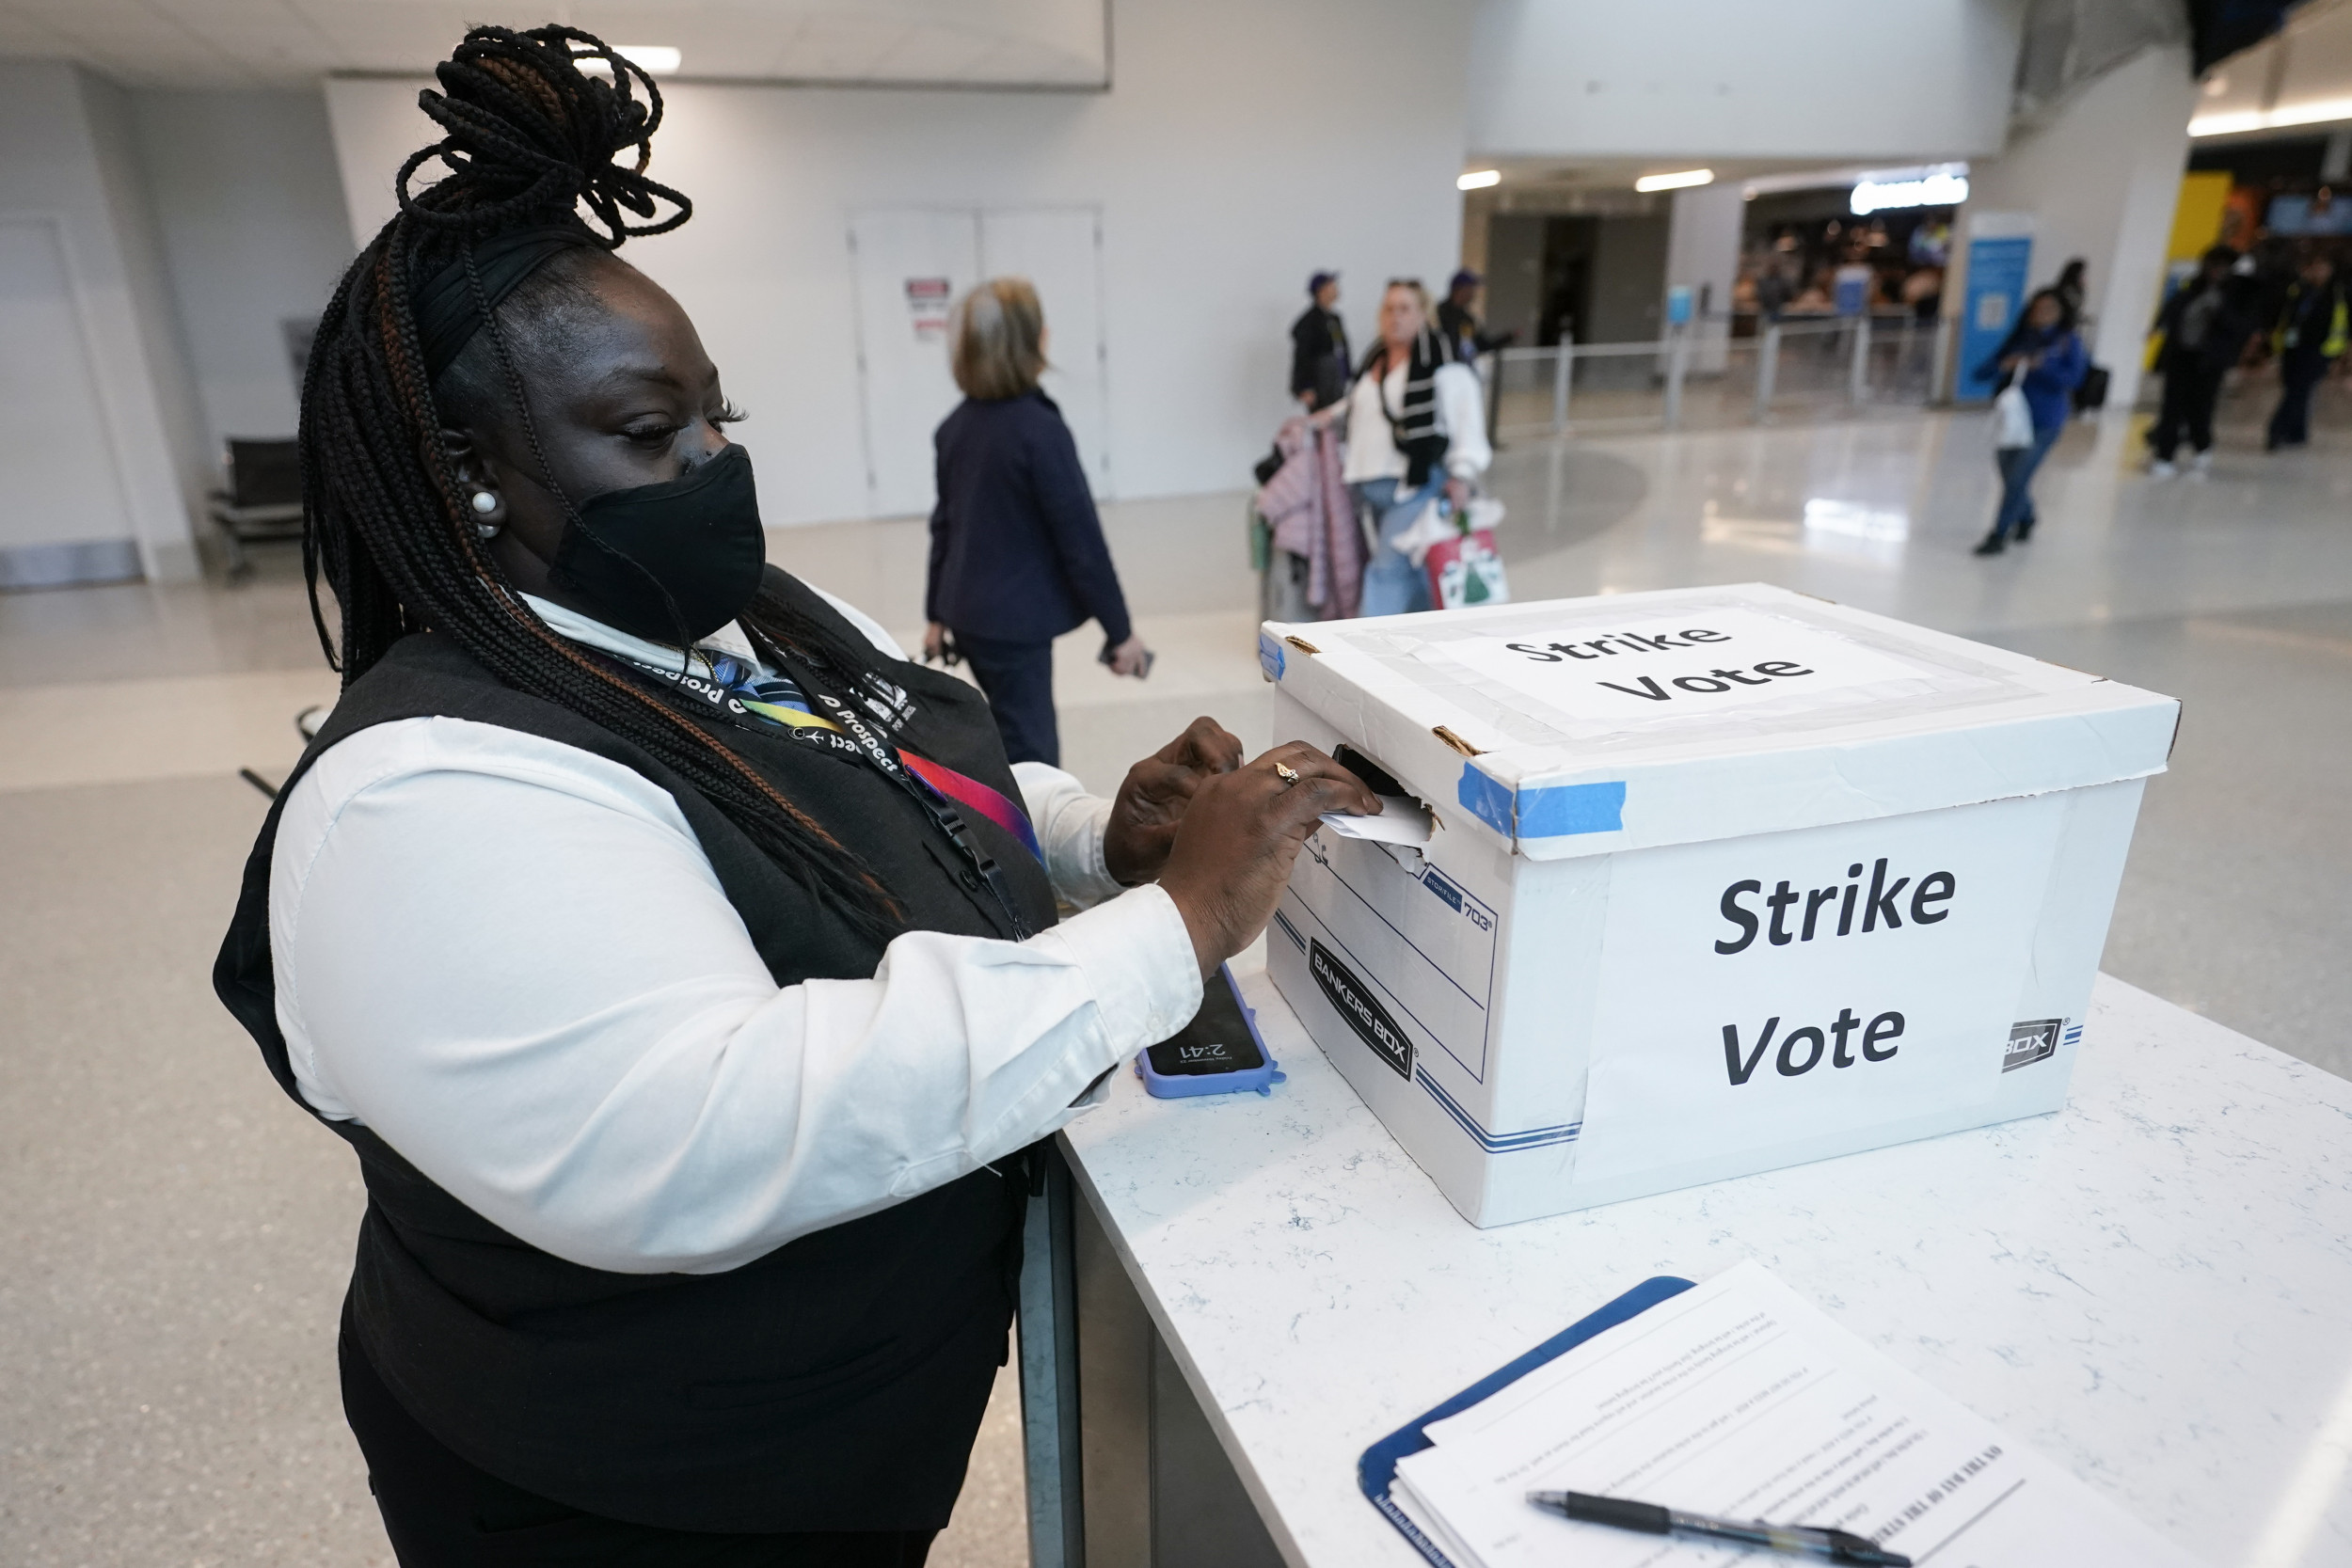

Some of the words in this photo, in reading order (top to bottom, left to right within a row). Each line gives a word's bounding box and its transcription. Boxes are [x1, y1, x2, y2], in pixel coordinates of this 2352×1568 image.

[1505, 629, 1732, 662] Strike
[1596, 661, 1814, 701] Vote
[836, 710, 898, 771] Prospect
[1714, 857, 1956, 955] Strike
[1314, 953, 1373, 1027] BANKERS
[1374, 1018, 1406, 1064] BOX
[1179, 1043, 1226, 1059] 2:41
[1722, 1007, 1905, 1085] Vote
[1982, 1445, 2002, 1460] ON
[1962, 1457, 1987, 1476] THE
[1940, 1472, 1965, 1492] DAY
[1902, 1500, 1929, 1520] THE
[1926, 1489, 1944, 1504] OF
[1869, 1518, 1905, 1545] STRI
